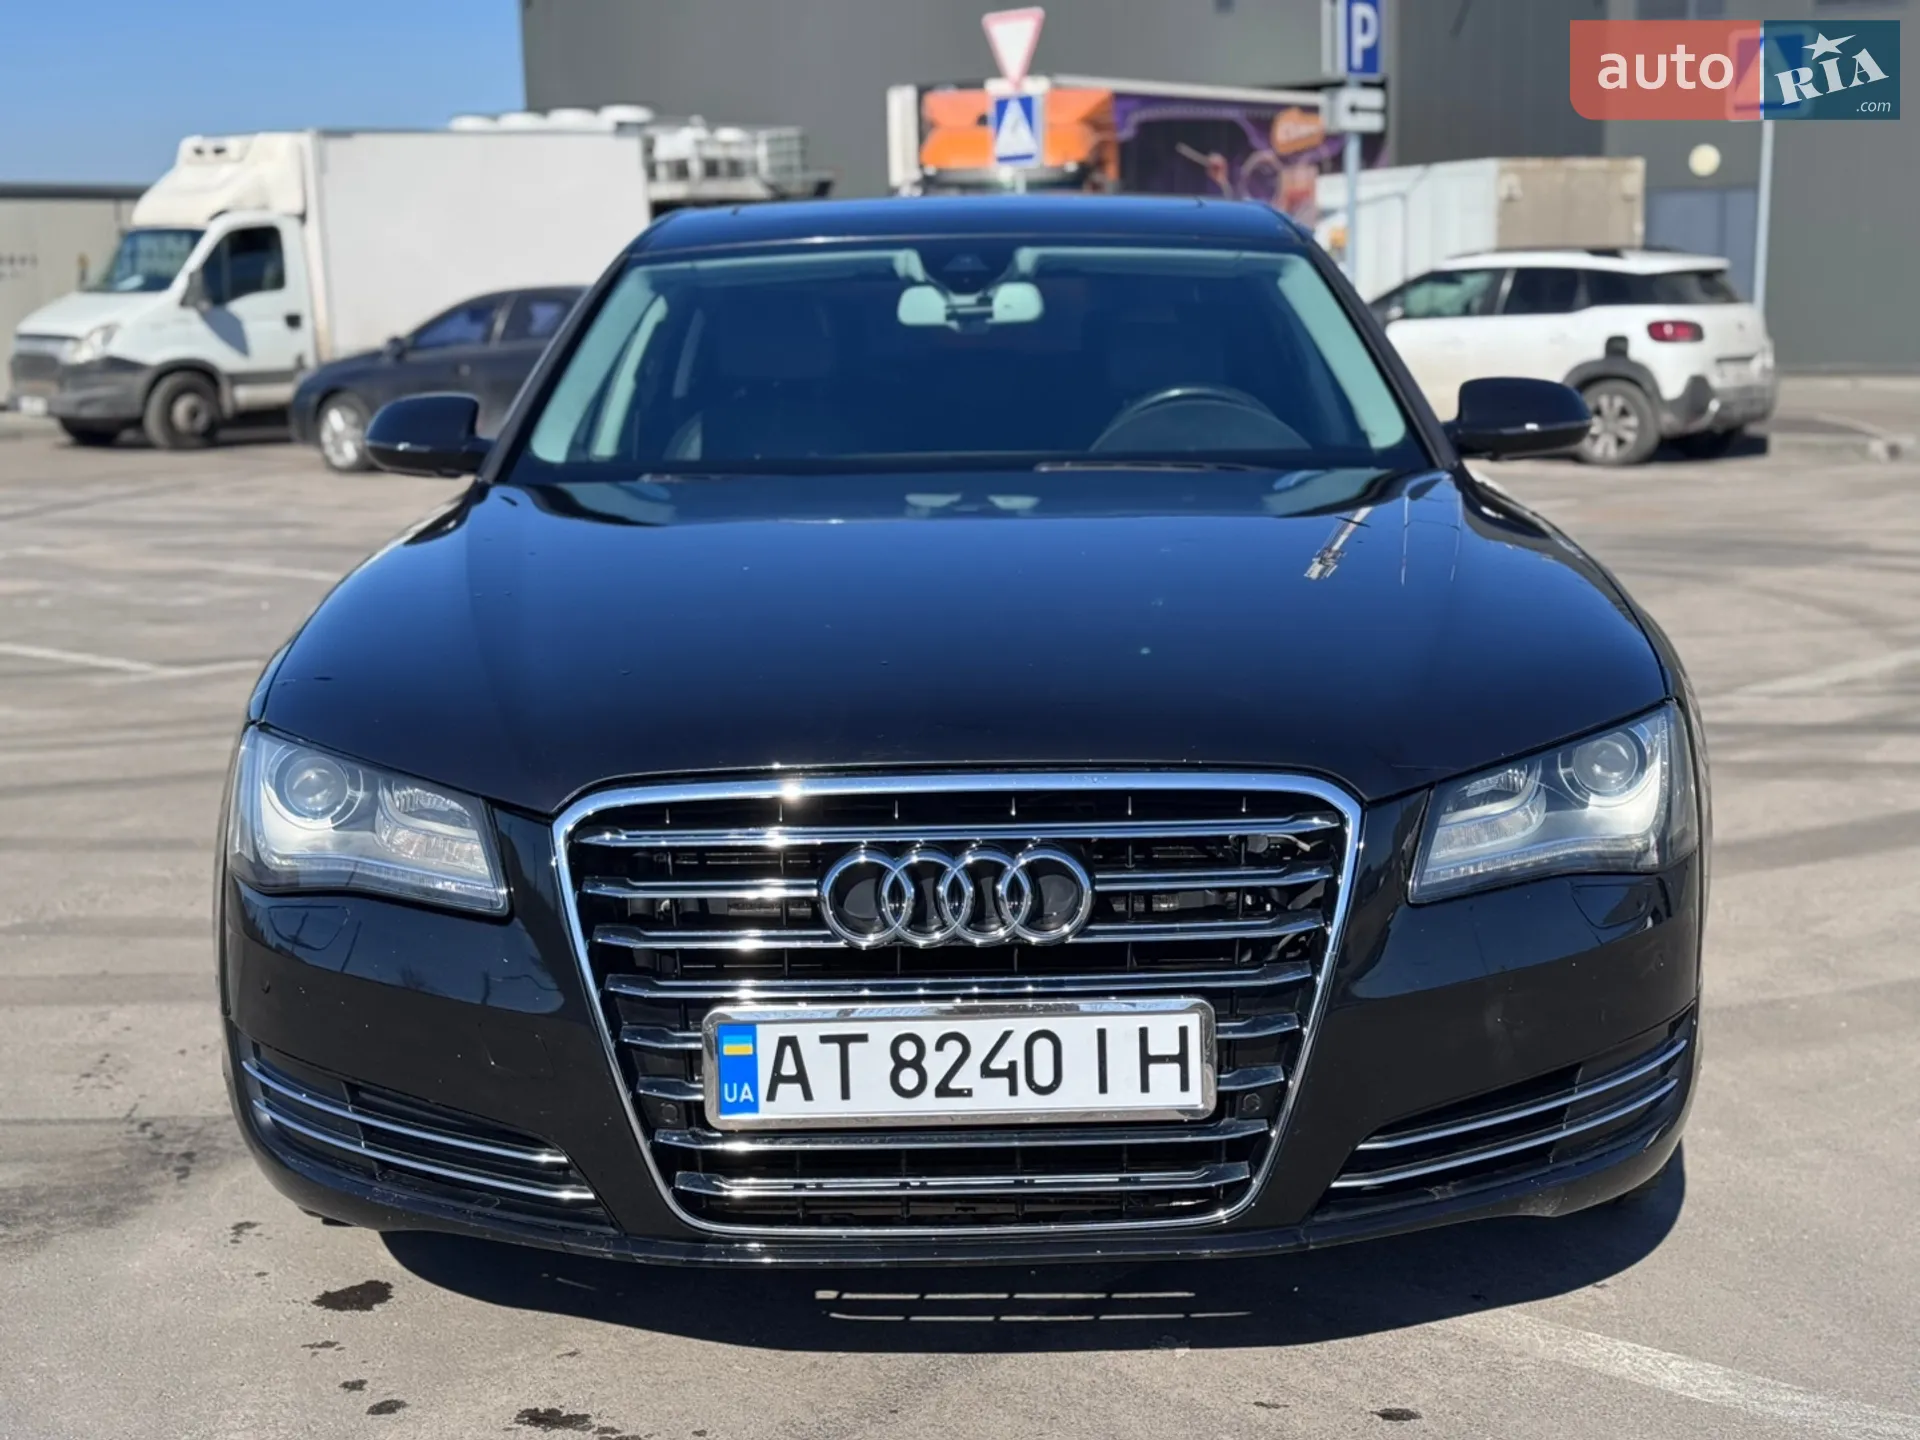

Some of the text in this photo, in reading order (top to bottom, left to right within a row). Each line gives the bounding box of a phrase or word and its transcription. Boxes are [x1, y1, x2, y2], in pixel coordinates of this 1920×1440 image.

[1350, 2, 1378, 70] P
[723, 1083, 754, 1103] UA
[766, 1025, 1191, 1102] AT 8240 IH
